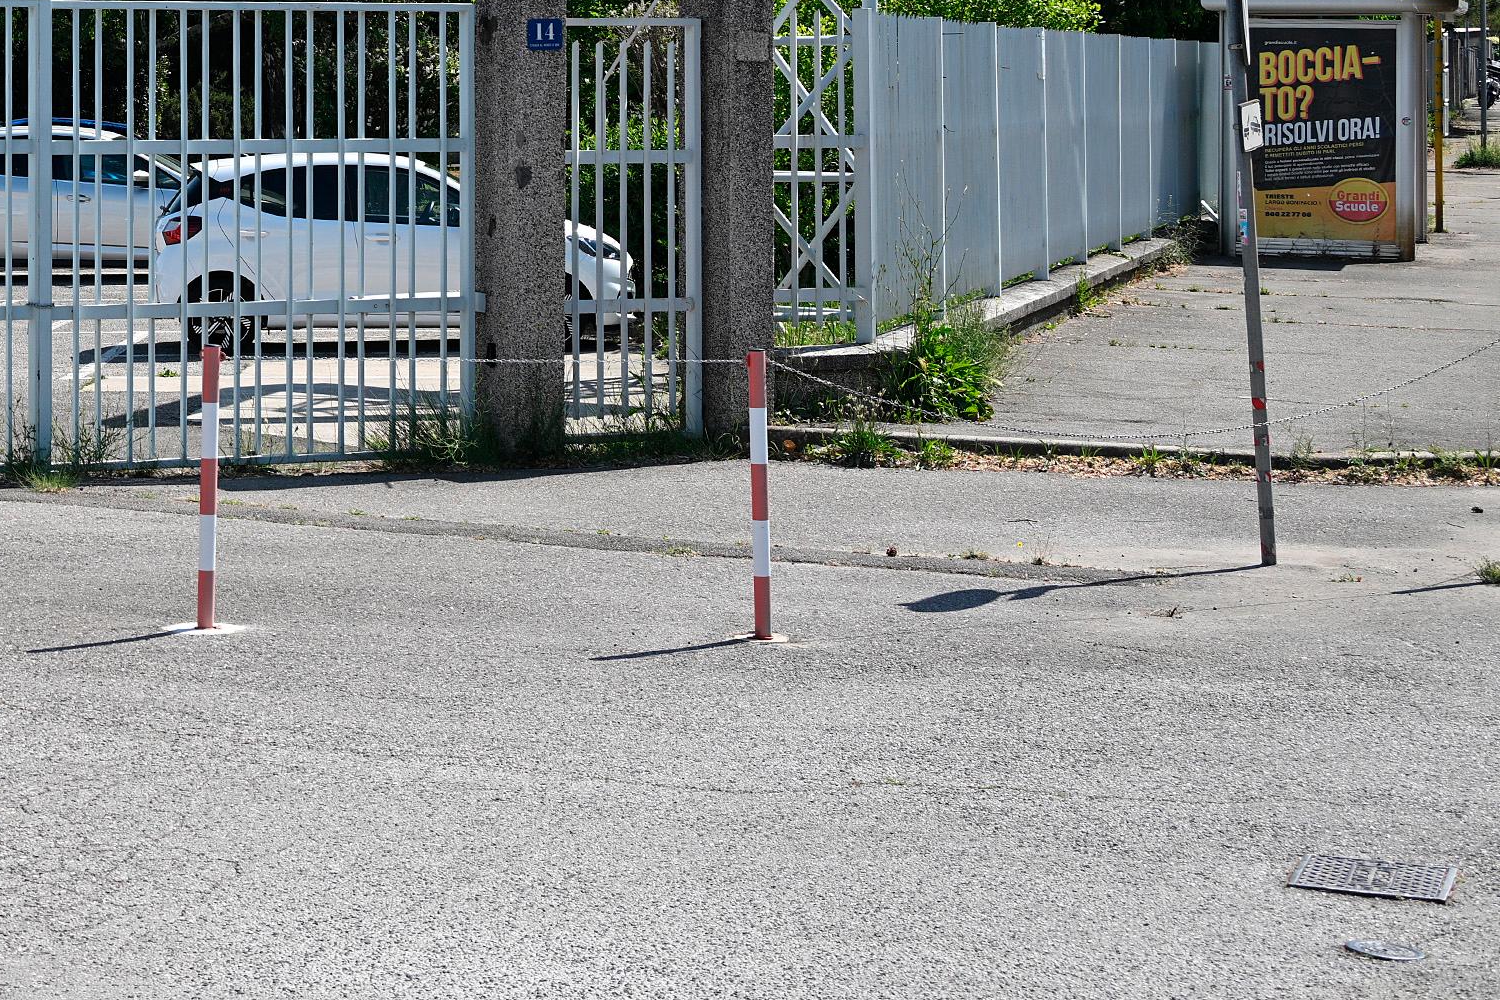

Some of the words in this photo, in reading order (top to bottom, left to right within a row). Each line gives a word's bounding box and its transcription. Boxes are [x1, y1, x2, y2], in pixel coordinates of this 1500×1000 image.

[535, 22, 556, 41] 14
[1259, 45, 1381, 87] BOCCIA-
[1259, 85, 1315, 121] TO?
[1264, 119, 1333, 147] RISOLVI
[1337, 116, 1381, 142] ORA!
[1335, 200, 1379, 212] Scuole
[1337, 190, 1380, 201] Grandi
